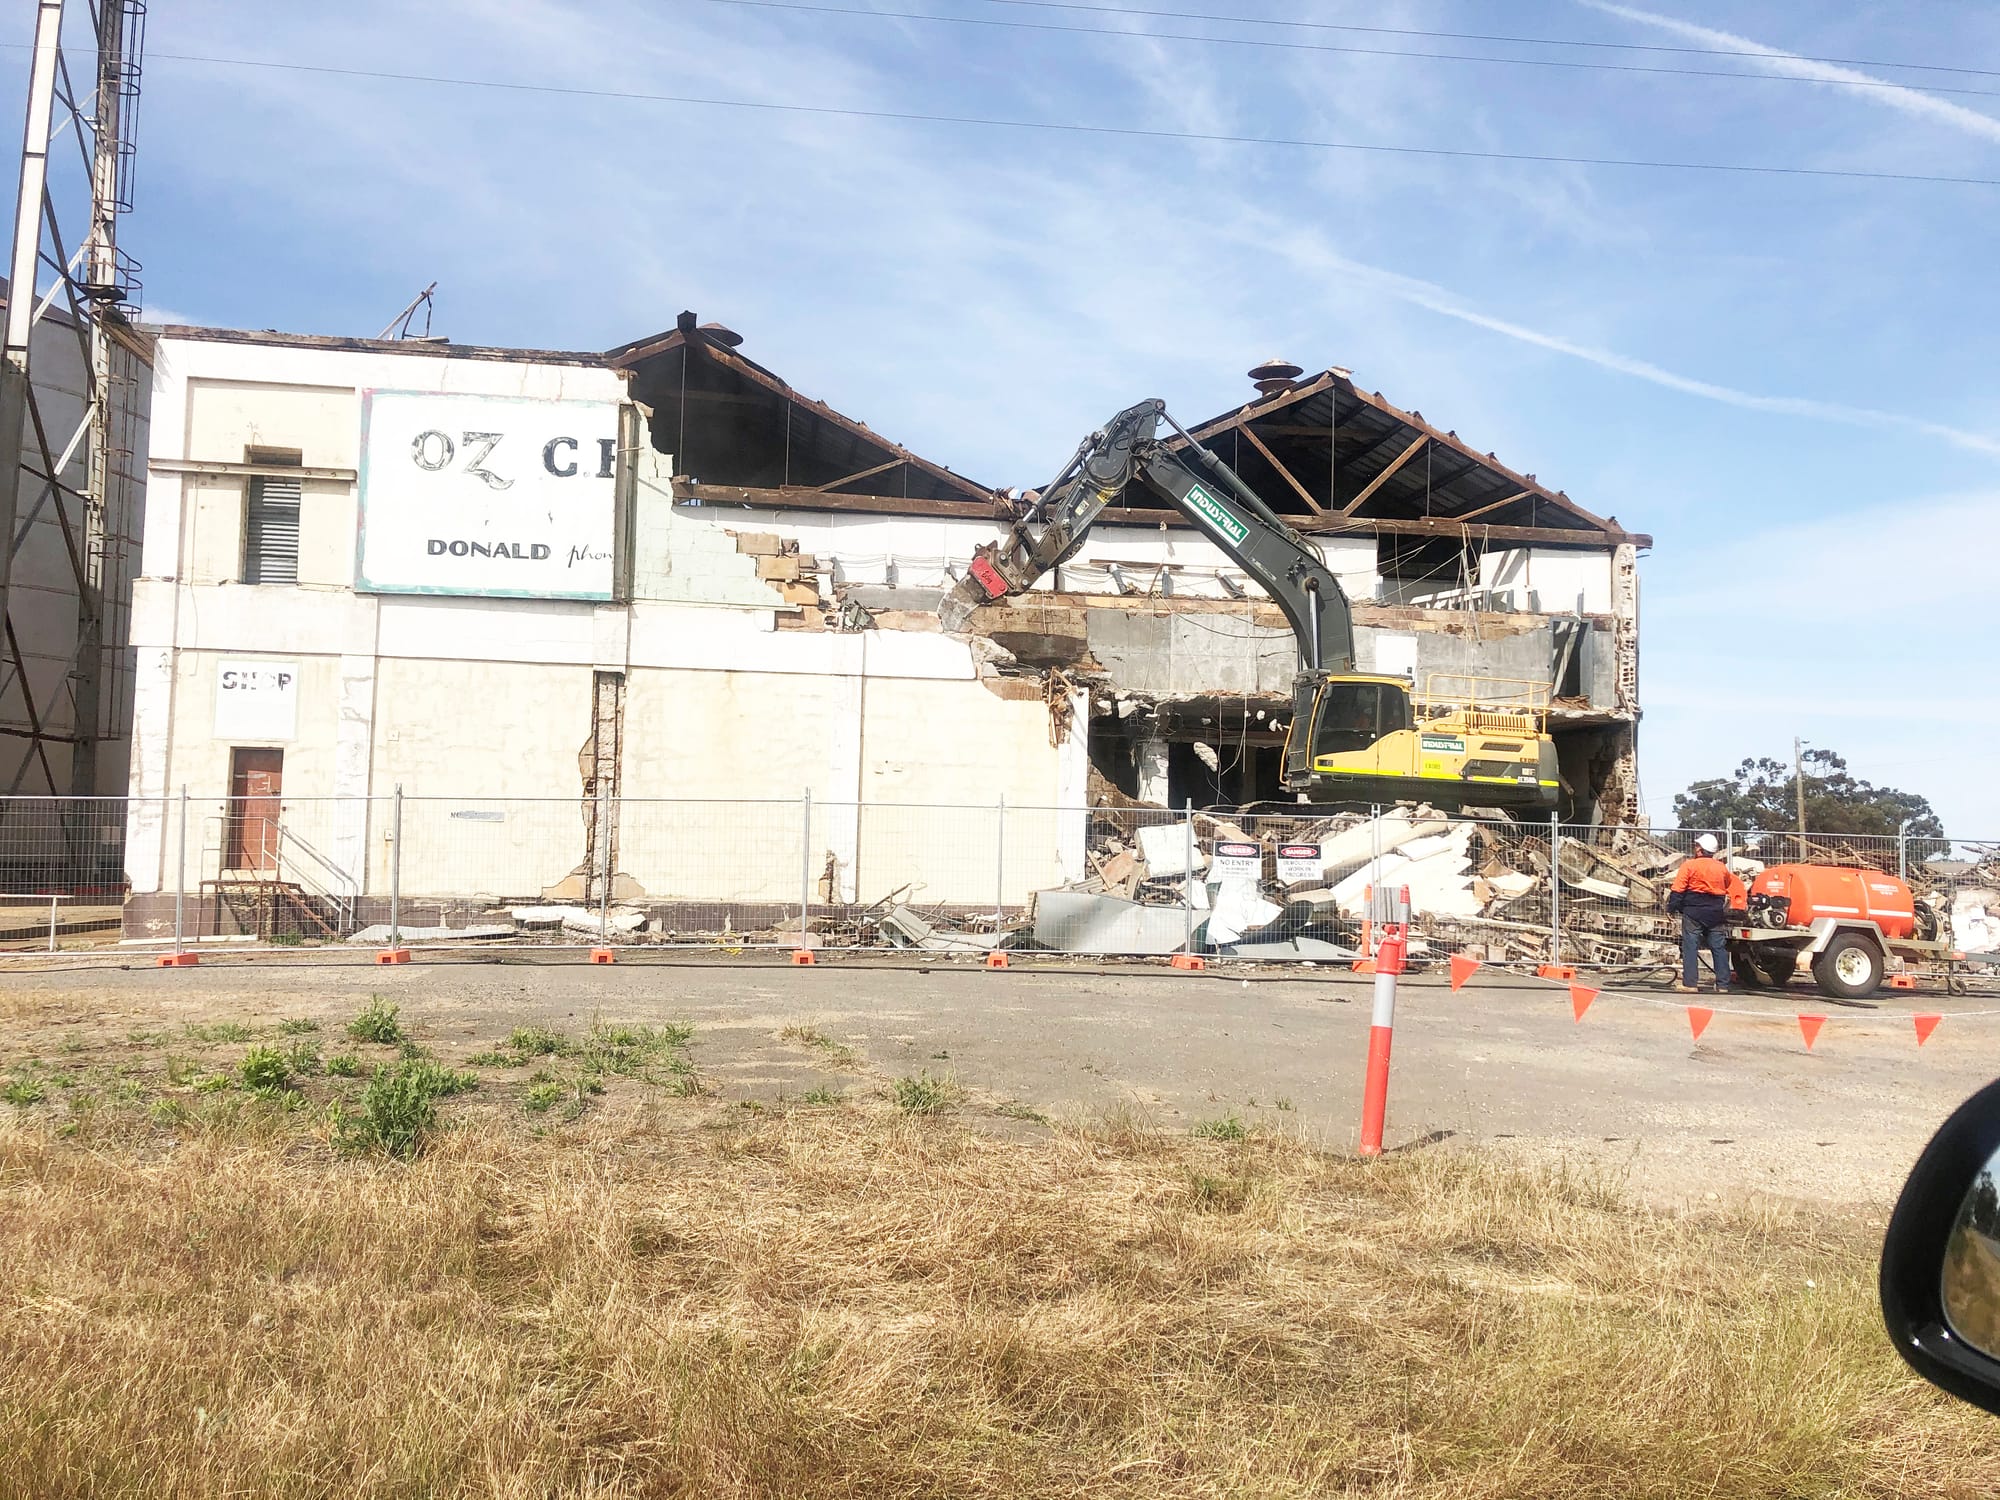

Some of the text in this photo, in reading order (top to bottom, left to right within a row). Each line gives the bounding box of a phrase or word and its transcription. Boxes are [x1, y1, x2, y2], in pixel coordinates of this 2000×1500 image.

[410, 429, 515, 490] OZ
[1190, 490, 1243, 540] INDUSTRIAL
[427, 539, 552, 560] DONALD
[222, 671, 292, 691] SHP
